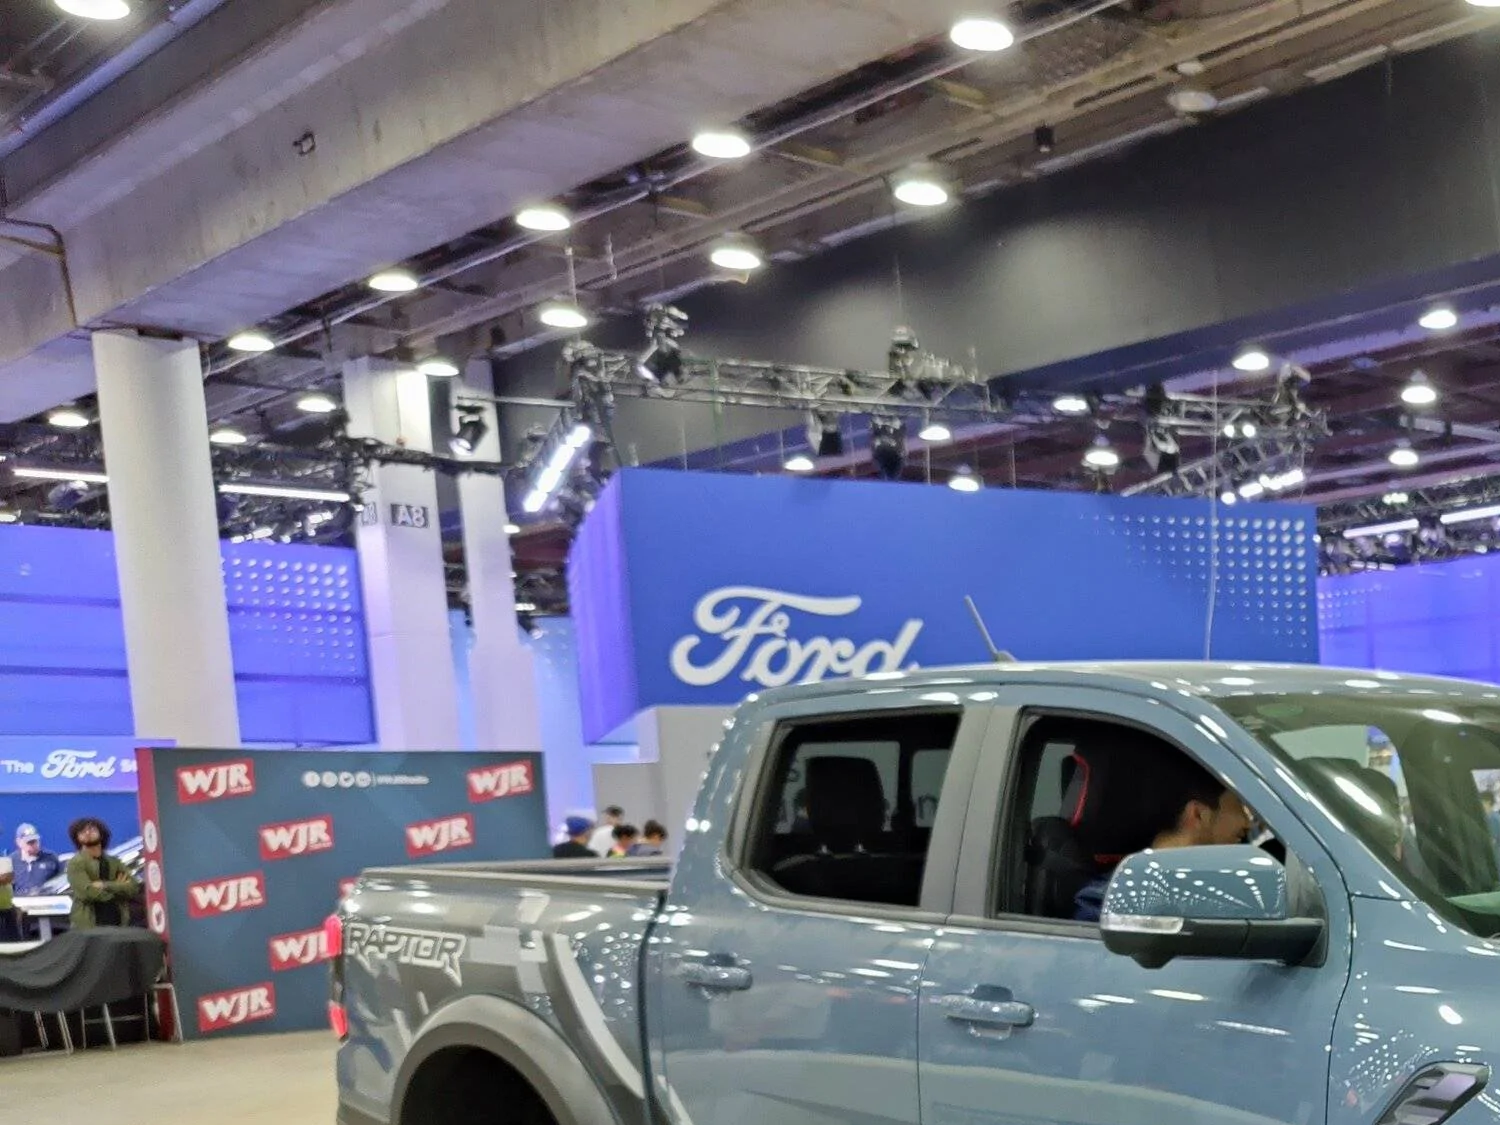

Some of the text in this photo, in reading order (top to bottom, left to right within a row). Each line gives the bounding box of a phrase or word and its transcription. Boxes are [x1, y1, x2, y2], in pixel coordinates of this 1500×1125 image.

[399, 505, 425, 528] A8
[669, 585, 924, 687] Ford
[41, 749, 116, 778] Ford
[180, 763, 252, 798] WJR
[468, 764, 530, 797] WJR
[262, 819, 331, 854] WJR
[407, 817, 471, 851] WJR
[191, 876, 262, 912] WJR
[346, 922, 466, 987] RAPTOR
[201, 987, 272, 1023] WJR
